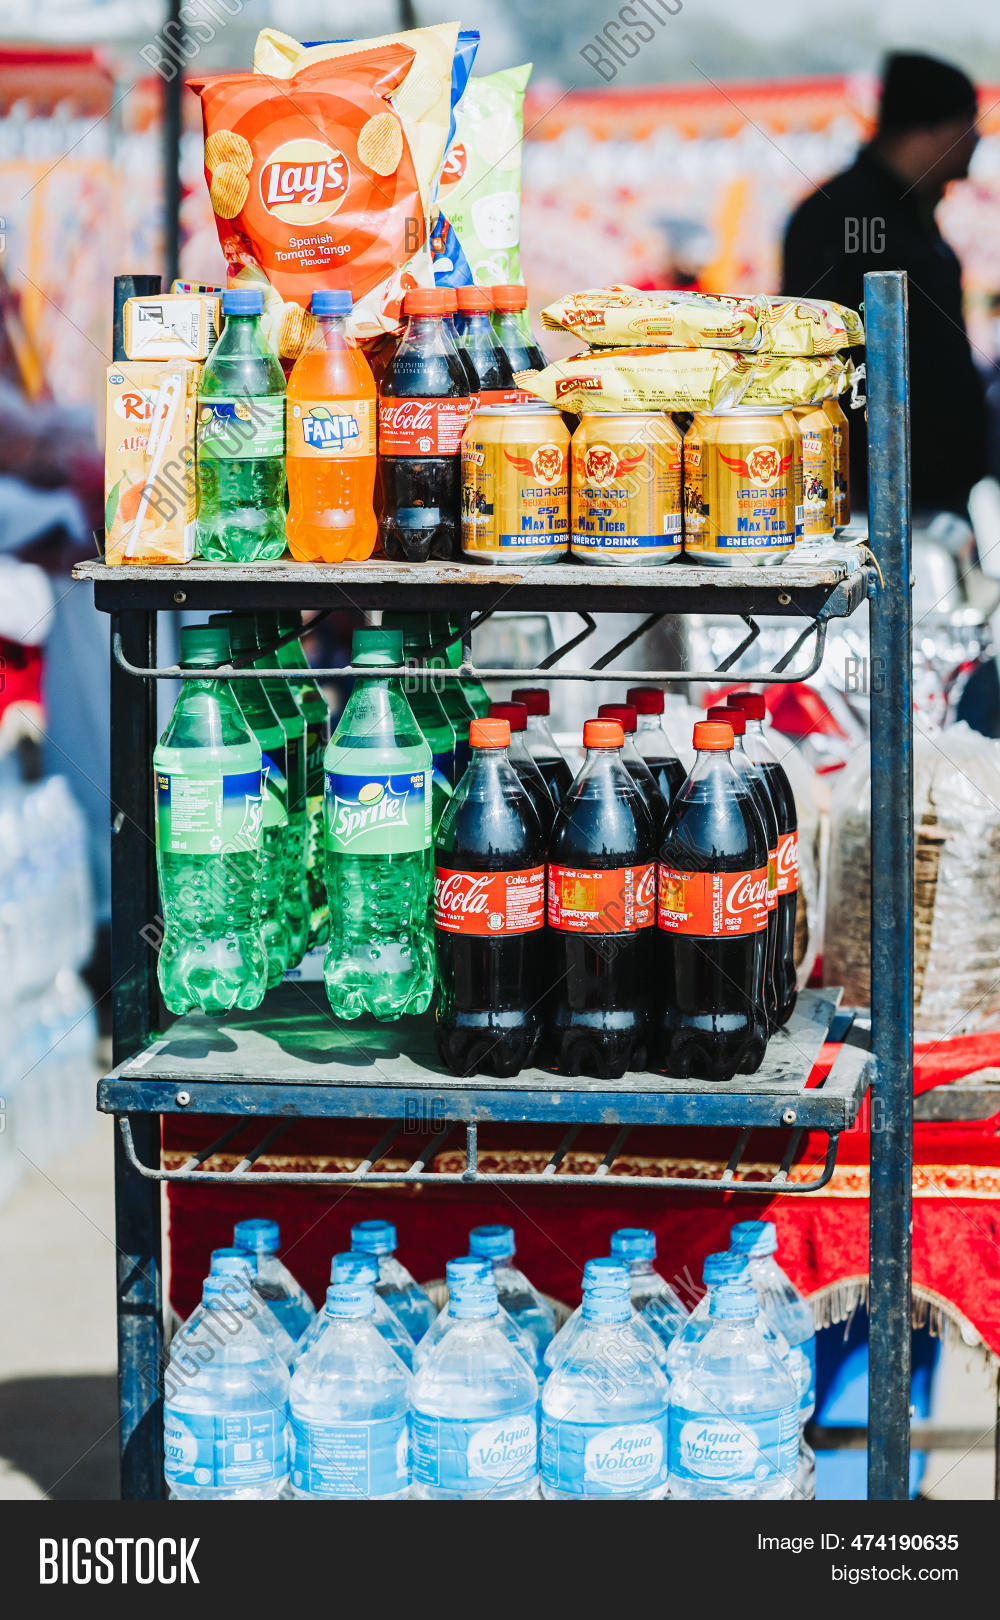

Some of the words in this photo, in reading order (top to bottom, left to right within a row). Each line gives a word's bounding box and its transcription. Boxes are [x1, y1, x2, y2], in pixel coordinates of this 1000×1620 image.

[267, 155, 345, 206] Lay's
[288, 234, 334, 249] Spanish
[275, 246, 316, 262] Tomato
[317, 243, 351, 258] Tango
[300, 256, 331, 267] Flavour
[110, 376, 124, 384] CG
[303, 416, 359, 442] FANTA
[537, 506, 560, 515] 250
[589, 508, 612, 517] 250
[753, 508, 777, 517] 250
[511, 535, 552, 544] ENERGY
[605, 537, 639, 546] DRINK
[727, 537, 768, 546] ENERGY
[771, 535, 793, 545] DRINK
[335, 792, 400, 838] Sprite
[712, 875, 720, 889] ME
[712, 891, 720, 933] RECYCLE
[493, 1425, 530, 1445] Aqua
[696, 1428, 741, 1446] Aqua
[610, 1436, 653, 1453] Aqua
[686, 1441, 743, 1462] Volcan
[479, 1442, 533, 1465] Volcan
[594, 1452, 655, 1471] Volcan
